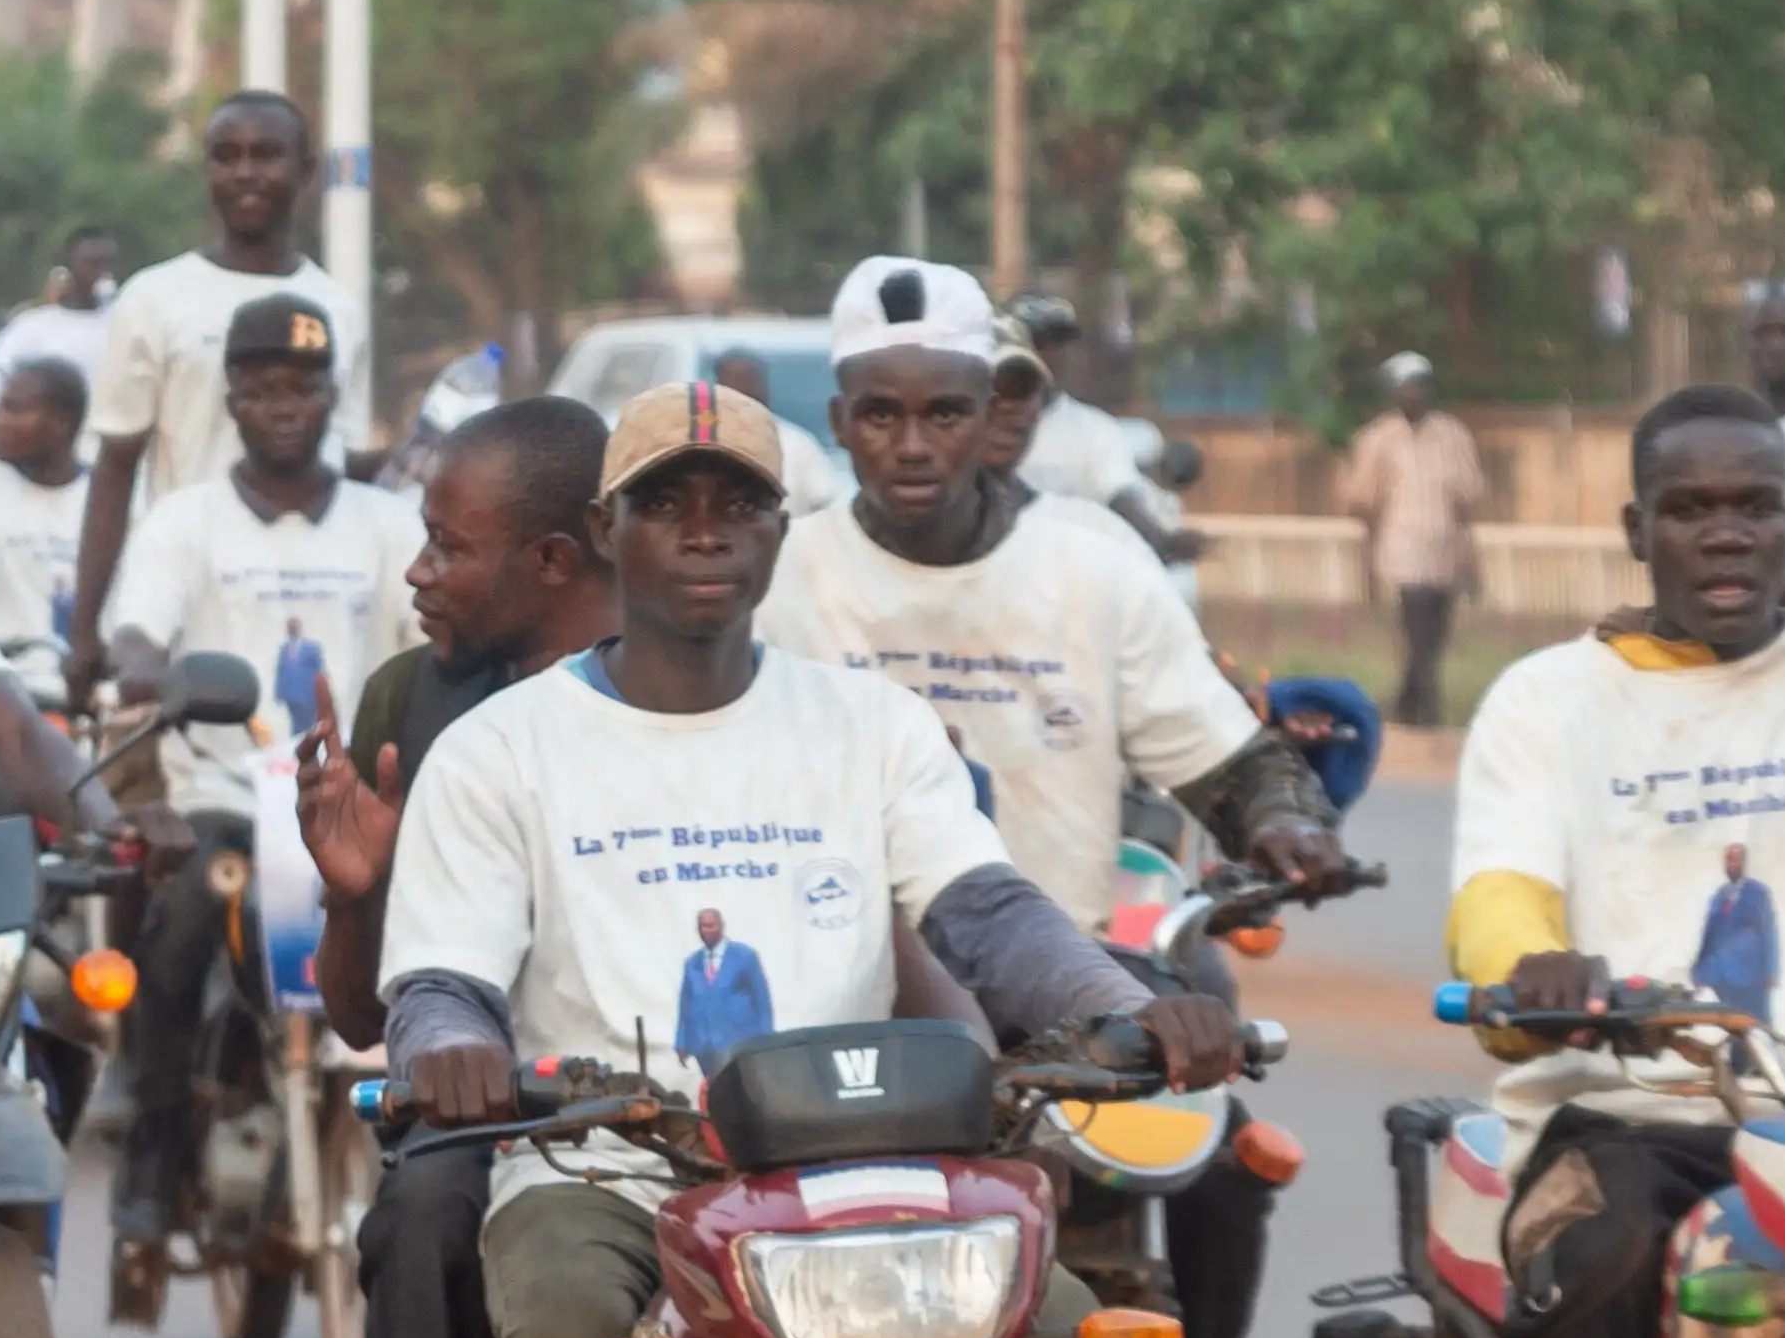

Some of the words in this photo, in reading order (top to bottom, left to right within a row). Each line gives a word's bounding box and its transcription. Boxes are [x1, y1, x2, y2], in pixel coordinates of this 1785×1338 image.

[572, 835, 605, 855] La
[637, 865, 670, 884] en
[675, 860, 780, 882] Marche
